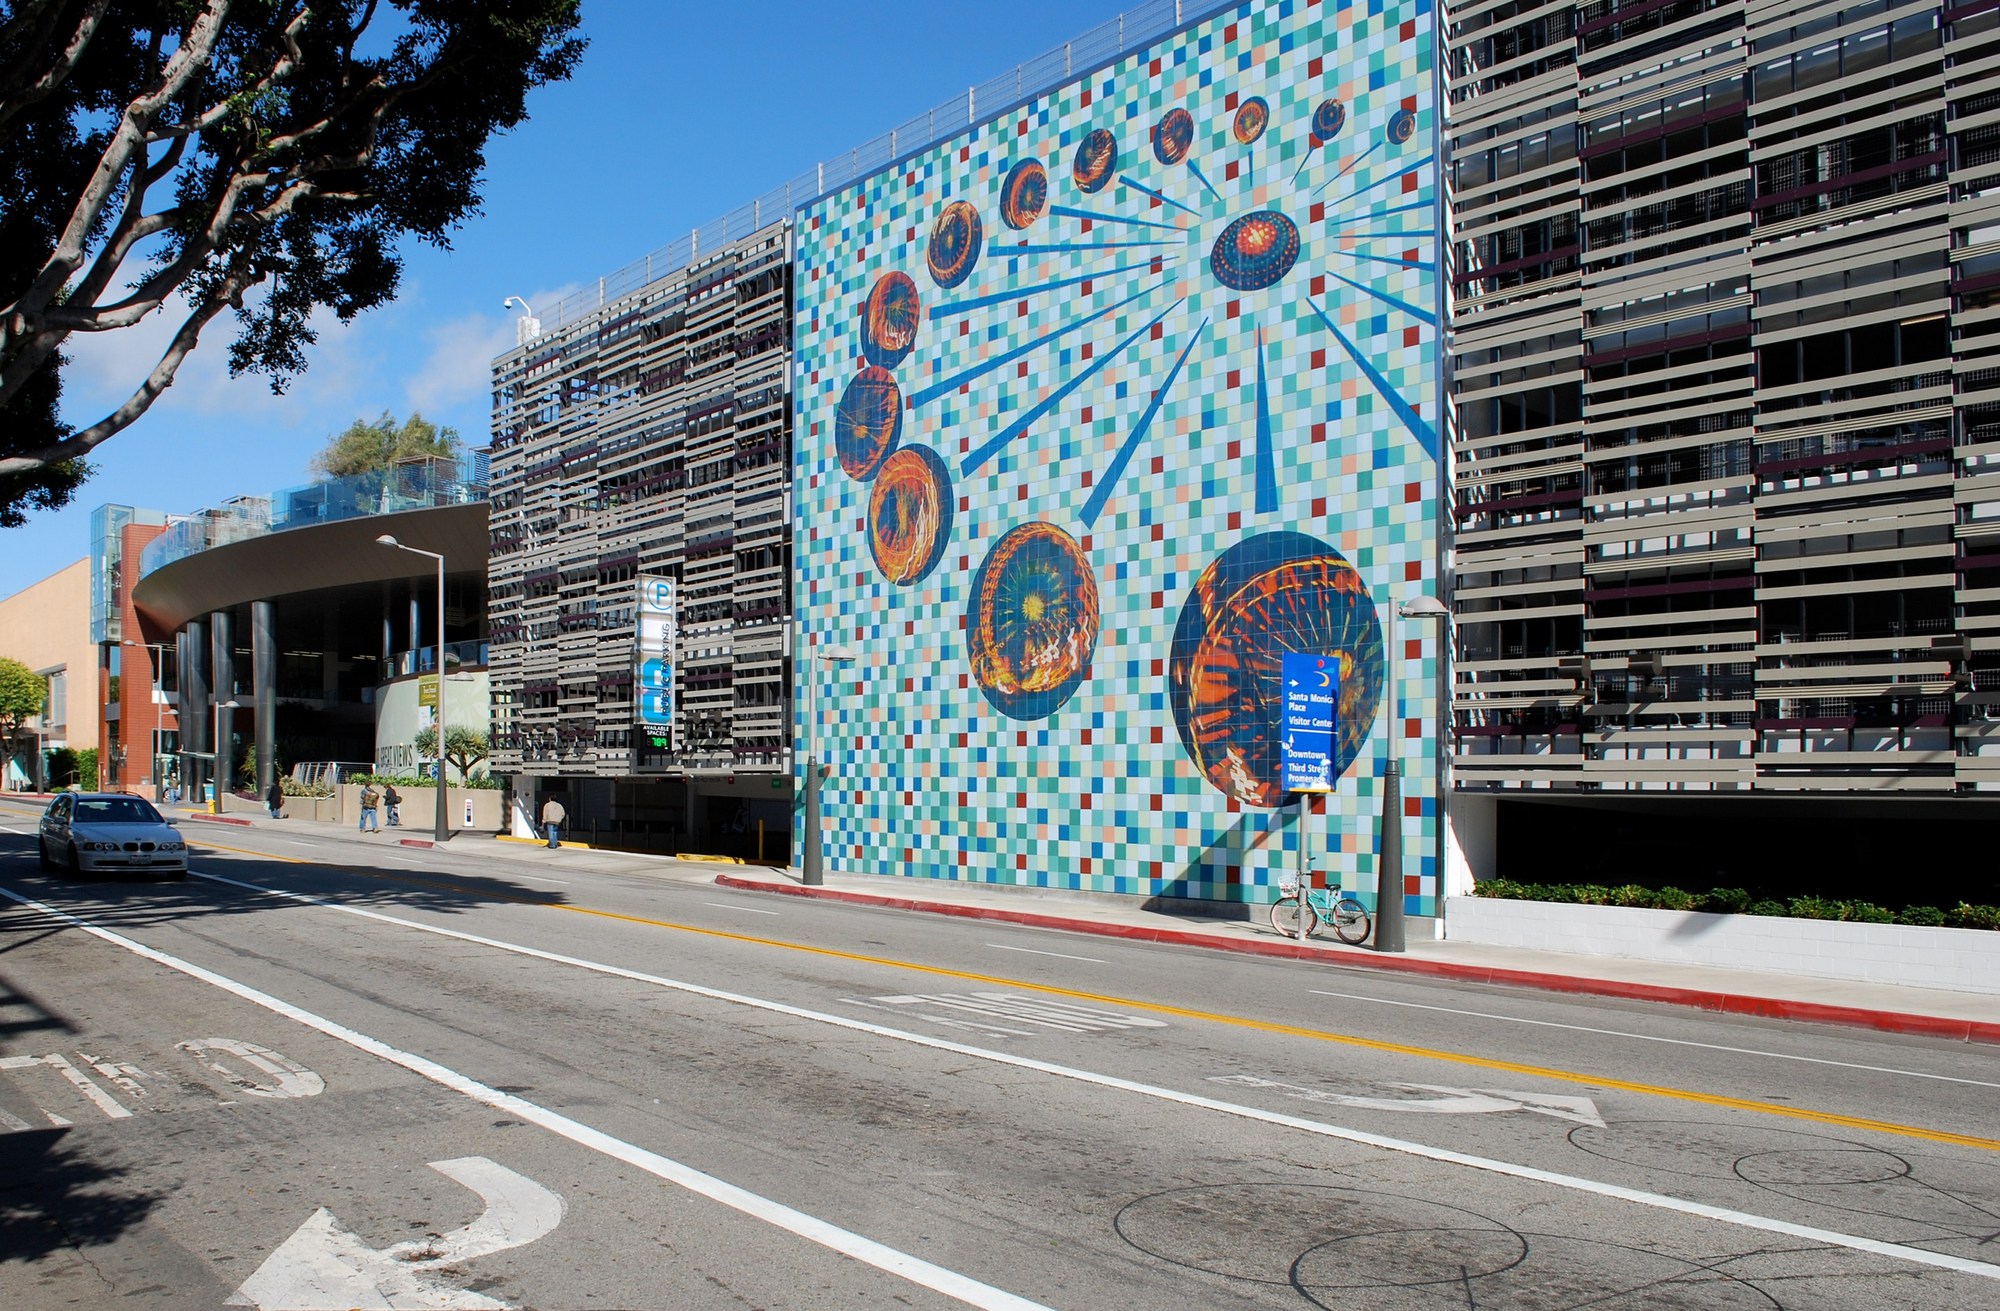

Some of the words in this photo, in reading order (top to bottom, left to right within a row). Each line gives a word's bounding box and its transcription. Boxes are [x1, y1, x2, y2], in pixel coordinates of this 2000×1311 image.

[656, 583, 670, 605] P
[661, 622, 671, 674] PARKING
[661, 676, 671, 717] PUBLIC
[1288, 691, 1309, 702] Santa
[1310, 693, 1334, 704] Monica
[1288, 701, 1307, 712] Place
[1288, 715, 1311, 726] Visitor
[1312, 717, 1333, 728] Center
[651, 737, 667, 747] 789
[393, 744, 413, 767] VIEWS
[1288, 749, 1327, 760] Downtown
[1288, 762, 1307, 773] Third
[1307, 763, 1329, 774] Street
